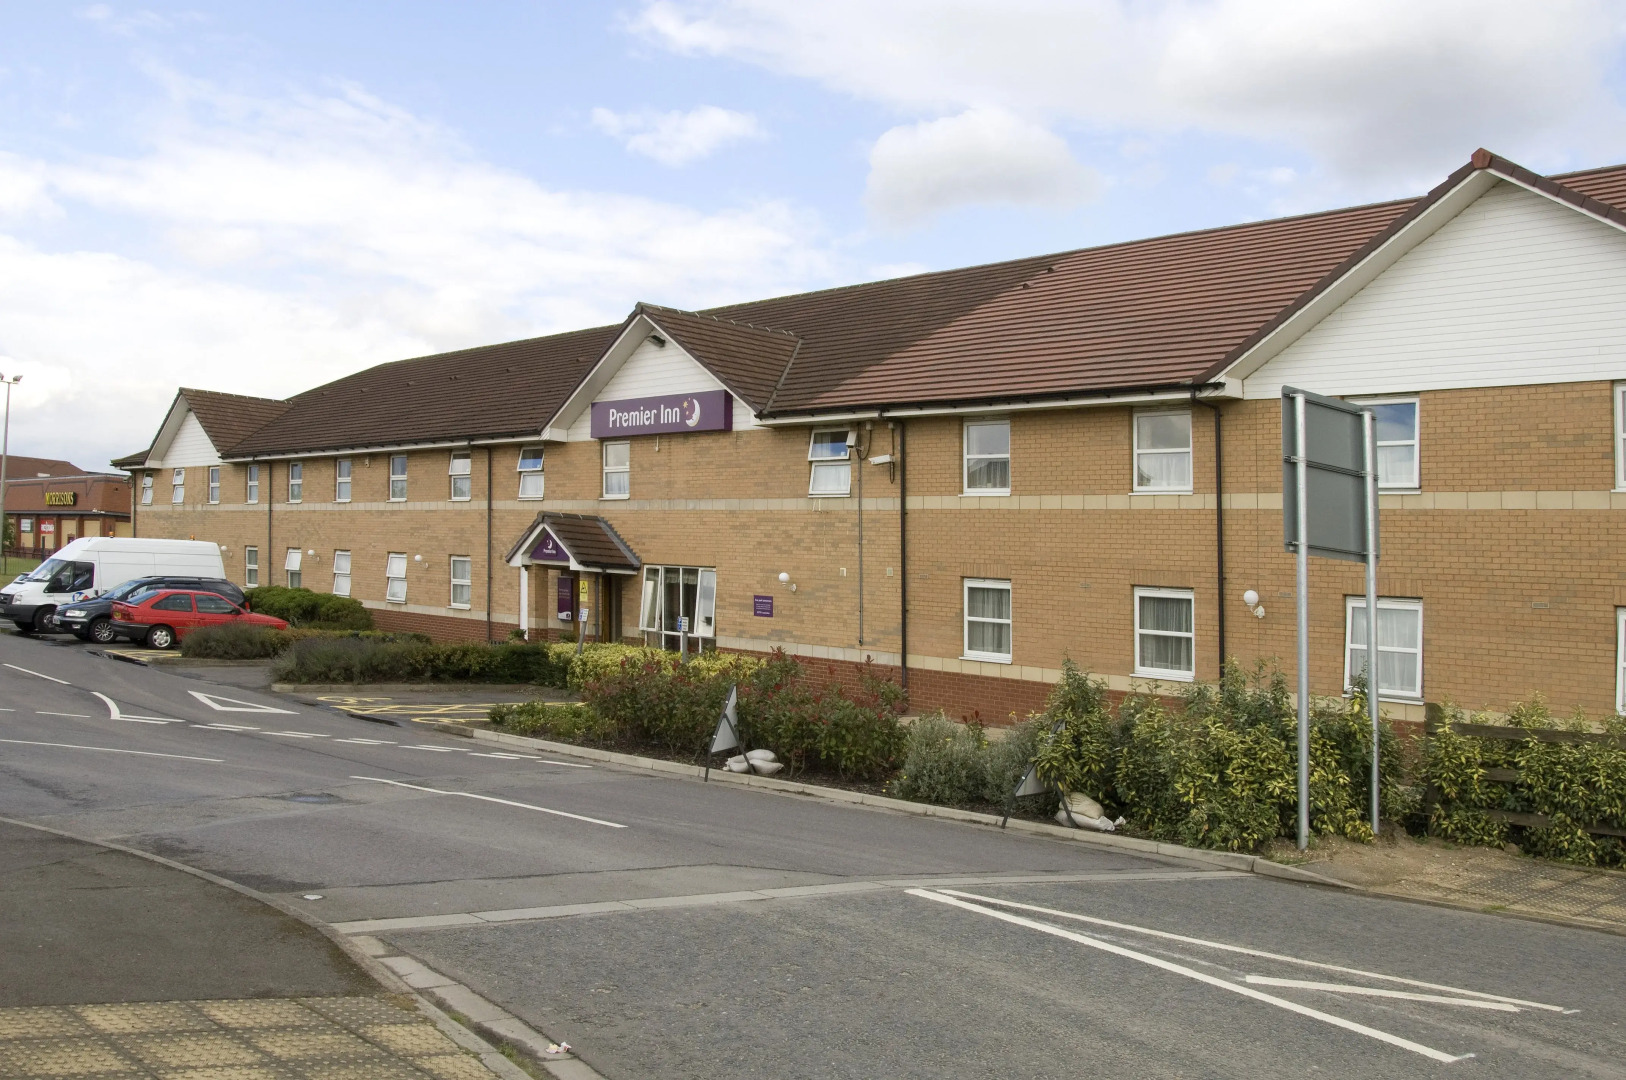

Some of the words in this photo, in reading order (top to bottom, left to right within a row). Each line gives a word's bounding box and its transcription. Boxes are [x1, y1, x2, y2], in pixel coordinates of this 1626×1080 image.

[609, 406, 657, 428] Premier
[660, 404, 680, 424] Inn
[45, 491, 74, 505] MORRISONS
